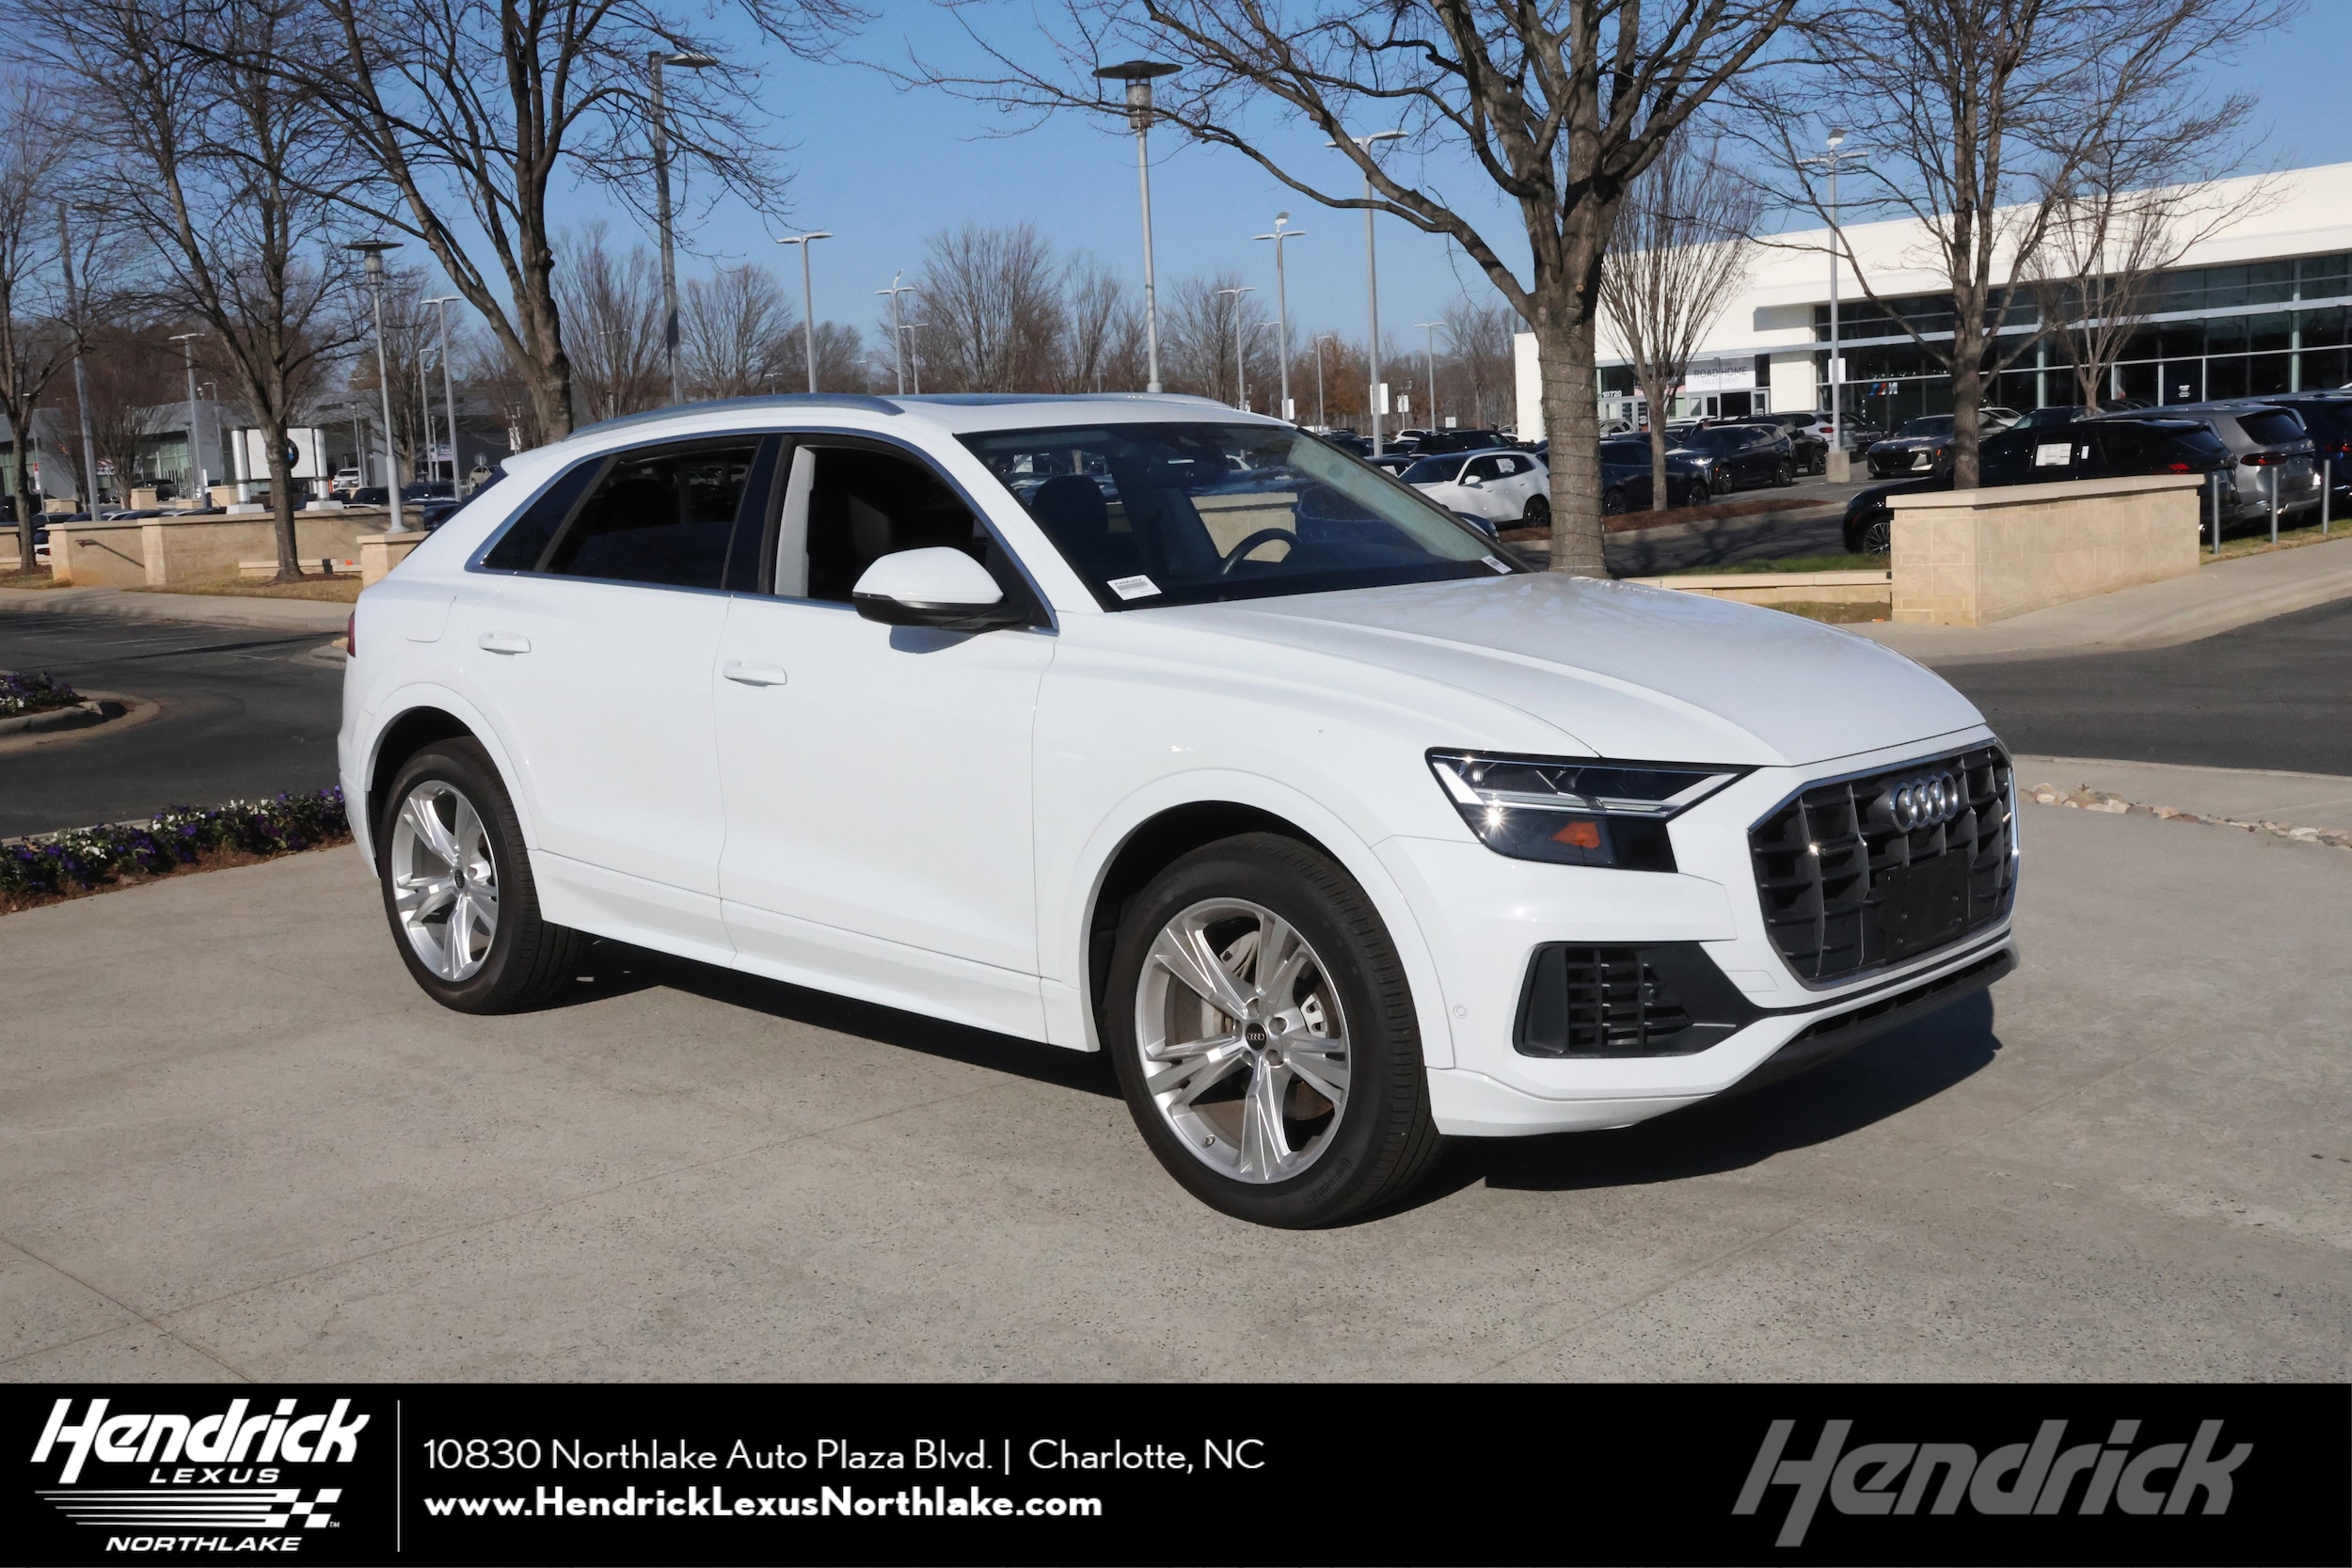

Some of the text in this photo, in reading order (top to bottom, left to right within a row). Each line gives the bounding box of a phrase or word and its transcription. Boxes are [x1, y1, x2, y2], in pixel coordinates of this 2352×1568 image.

[1693, 366, 1747, 378] ROAD HOME
[1601, 389, 1623, 398] 10720
